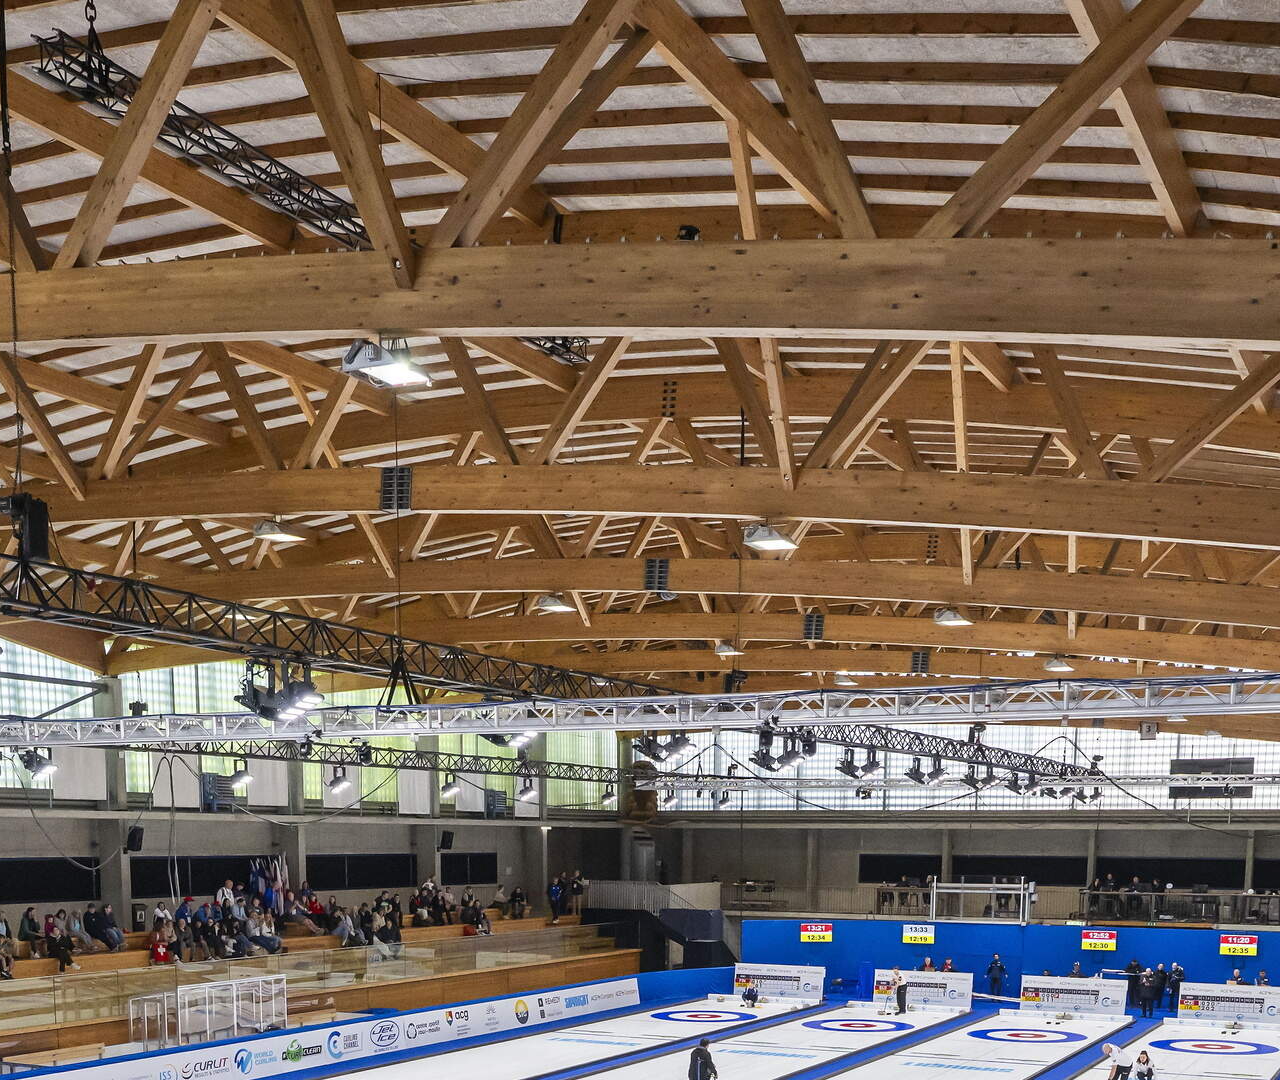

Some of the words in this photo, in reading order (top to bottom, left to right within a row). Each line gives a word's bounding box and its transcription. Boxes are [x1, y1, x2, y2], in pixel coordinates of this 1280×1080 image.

[1227, 936, 1250, 944] 11:20
[455, 1010, 469, 1021] acg
[373, 1024, 394, 1036] Jet
[376, 1032, 396, 1043] Ice
[254, 1050, 274, 1060] WORLD
[193, 1057, 229, 1073] CURLIT
[254, 1056, 278, 1066] CURLING
